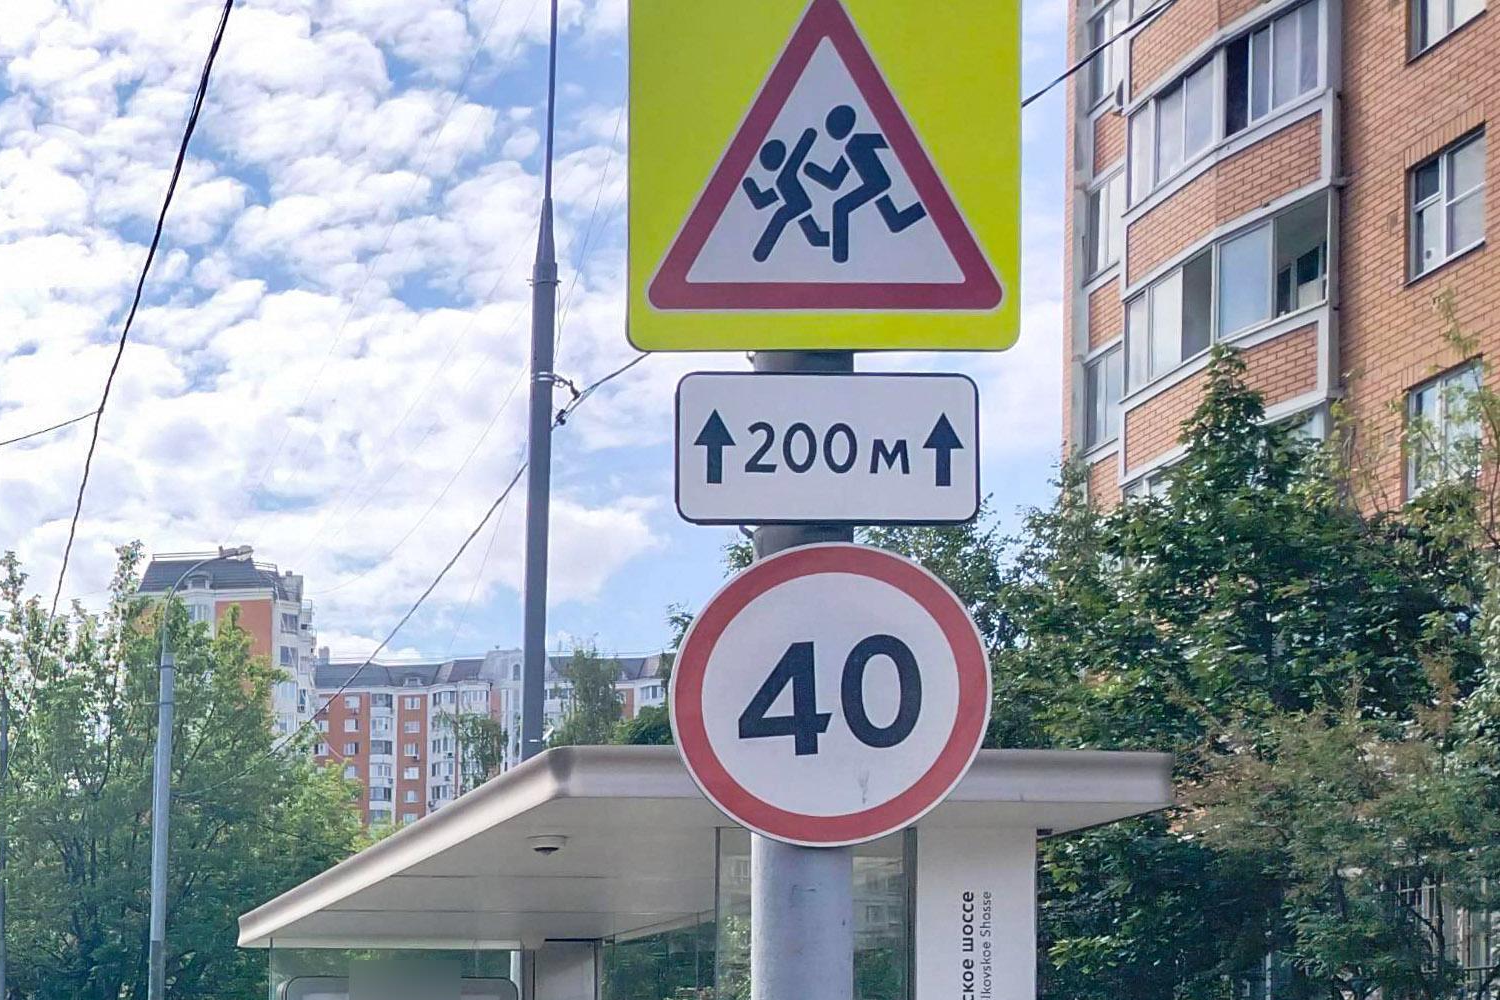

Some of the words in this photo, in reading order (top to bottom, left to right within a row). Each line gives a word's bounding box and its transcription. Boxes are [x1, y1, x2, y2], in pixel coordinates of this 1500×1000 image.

[744, 421, 858, 475] 200
[737, 633, 923, 757] 40
[962, 891, 975, 952] шоссе
[979, 891, 992, 937] Shosse
